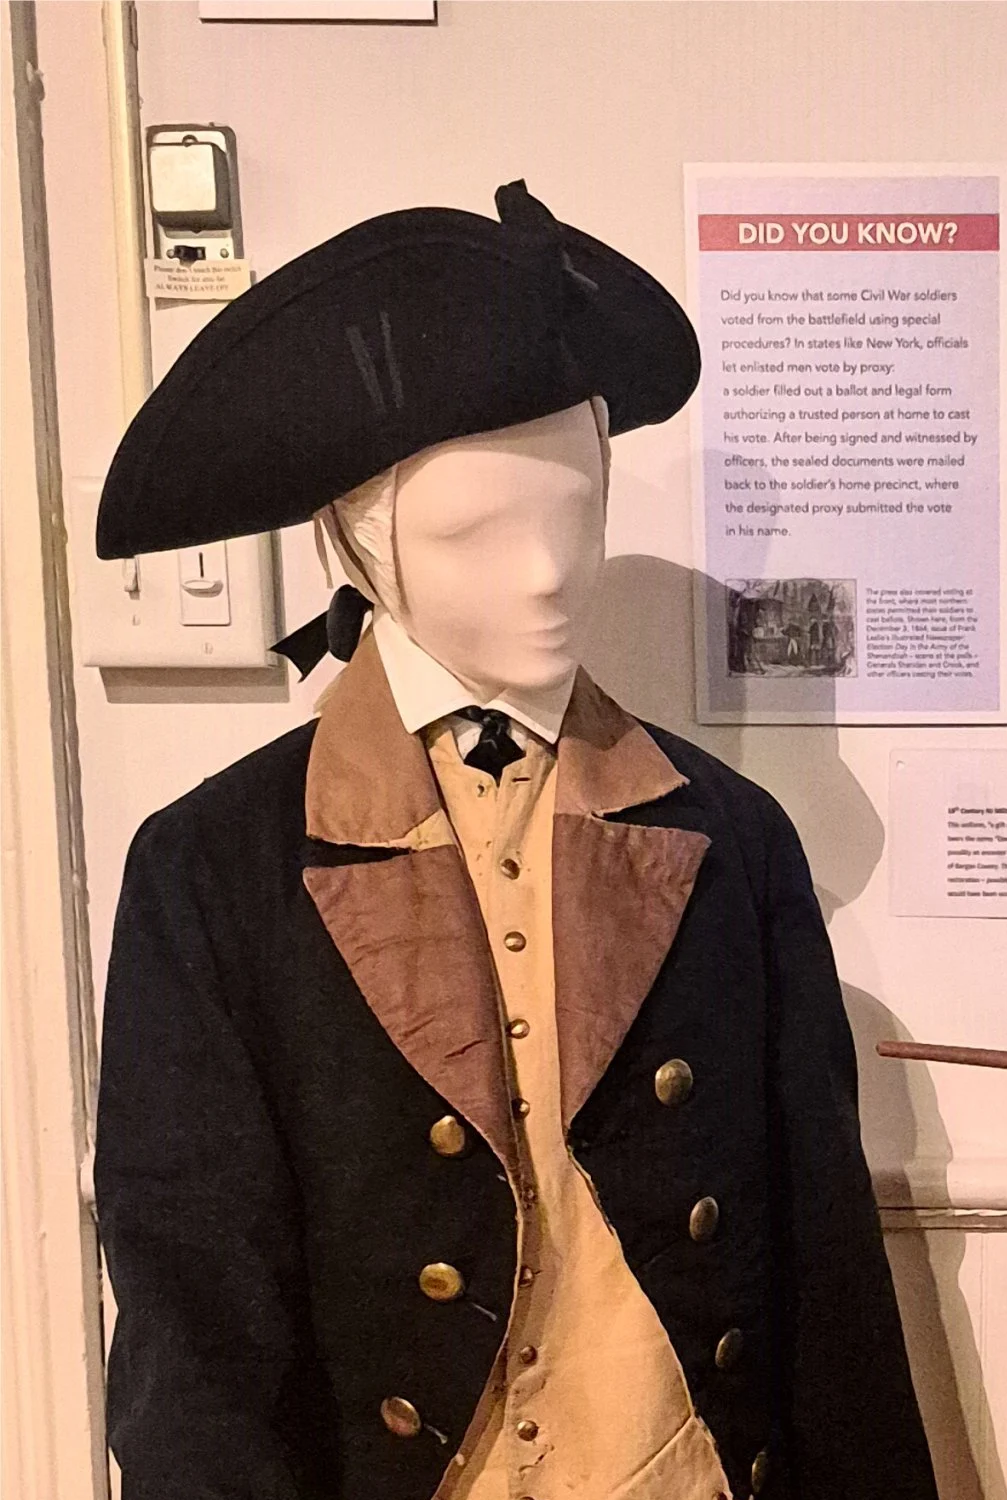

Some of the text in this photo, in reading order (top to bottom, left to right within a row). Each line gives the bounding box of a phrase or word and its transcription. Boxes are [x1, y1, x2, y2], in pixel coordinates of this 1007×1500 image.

[738, 222, 958, 244] DID YOU KNOW?
[720, 289, 957, 304] Did you know that some Civil War soldiers
[720, 313, 941, 328] voted from the battlefield using special
[721, 336, 968, 350] procedures? In states like New York, officials
[722, 361, 736, 372] let
[739, 361, 784, 372] enlisted
[786, 364, 812, 373] men
[814, 363, 840, 372] vote
[842, 360, 857, 376] by
[722, 384, 953, 399] a soldier filled out a ballot and legal form
[725, 524, 791, 536] in his name.
